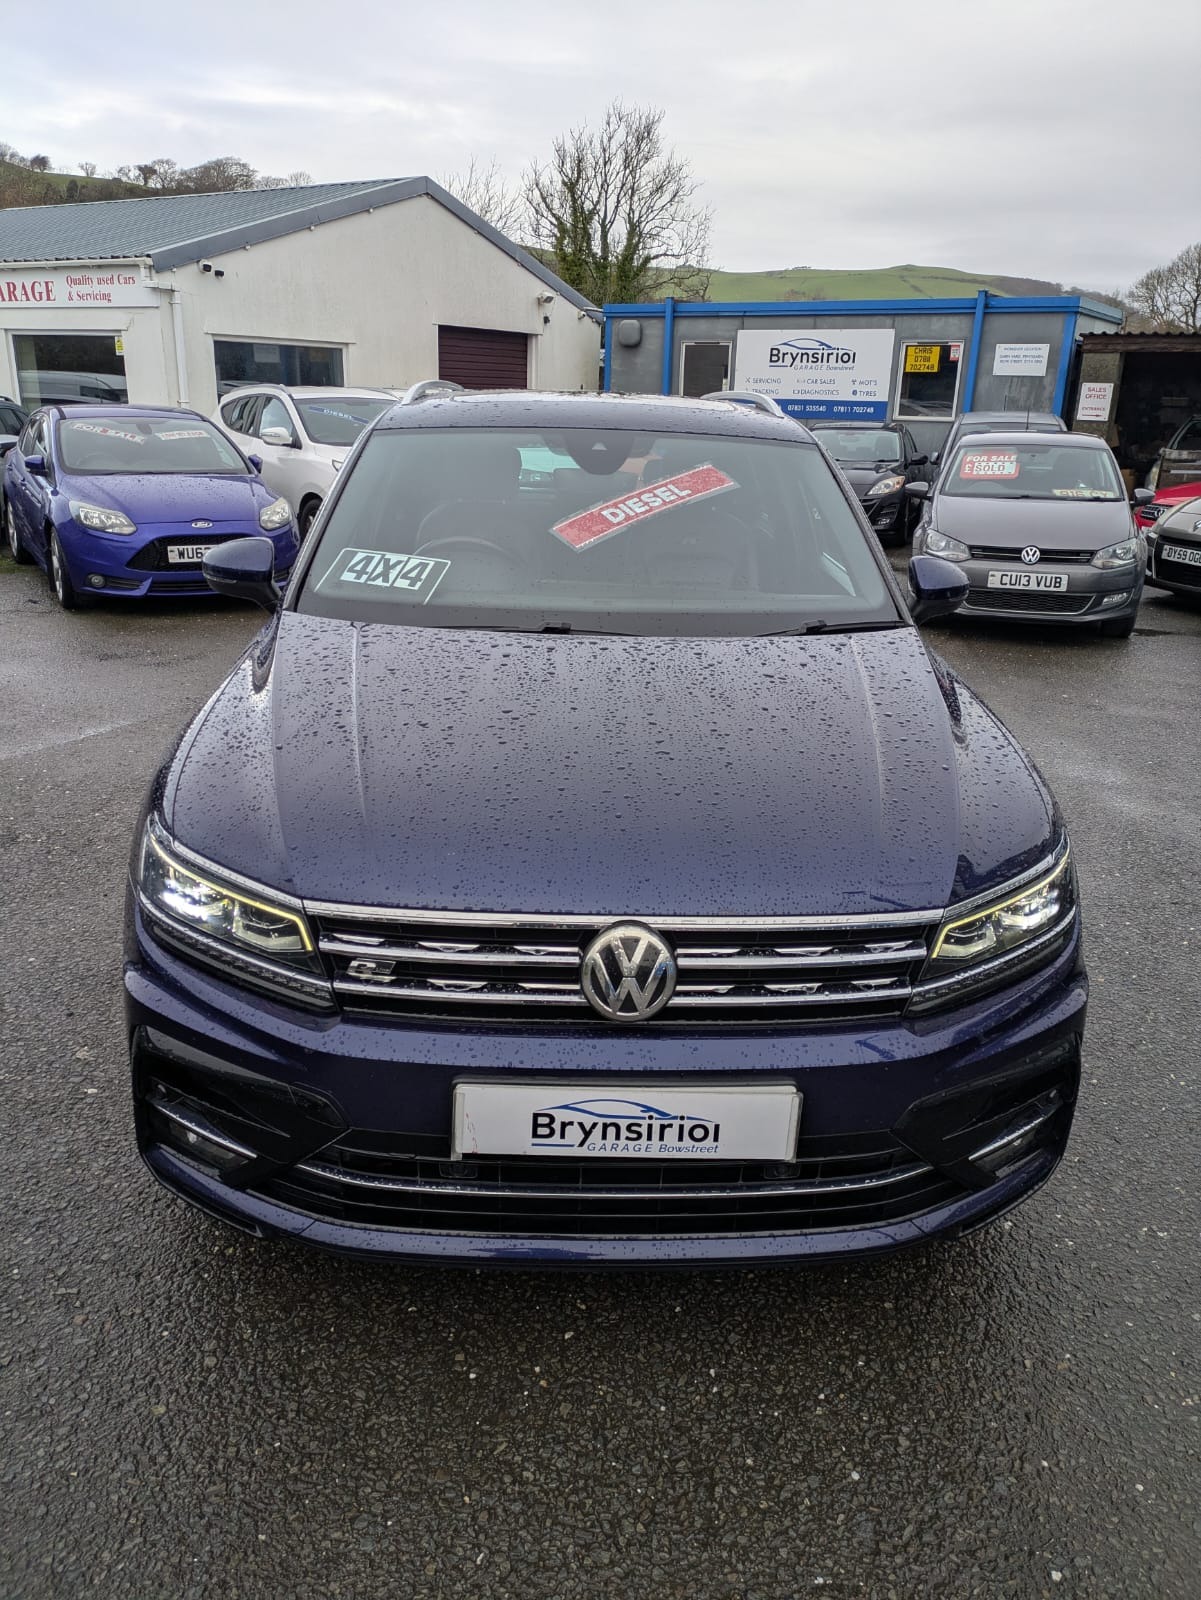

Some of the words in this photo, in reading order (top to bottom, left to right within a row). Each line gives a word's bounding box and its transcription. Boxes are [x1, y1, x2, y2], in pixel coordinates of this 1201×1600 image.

[66, 275, 95, 288] Quality
[97, 274, 115, 285] used
[117, 273, 136, 284] Cars
[67, 292, 74, 302] &
[76, 290, 112, 303] Servicing
[769, 347, 857, 368] Brynsiriol
[752, 377, 782, 385] SERVICING
[990, 454, 1018, 462] SALE
[975, 463, 1005, 472] SOLD
[600, 484, 692, 524] DIESEL
[1167, 547, 1188, 561] DY59
[345, 554, 431, 588] 4X4
[1000, 573, 1031, 587] CU13
[1036, 575, 1062, 588] VUB
[531, 1112, 720, 1147] Brynsiriol
[587, 1142, 653, 1153] GARAGE
[658, 1143, 719, 1153] Bowstreet
